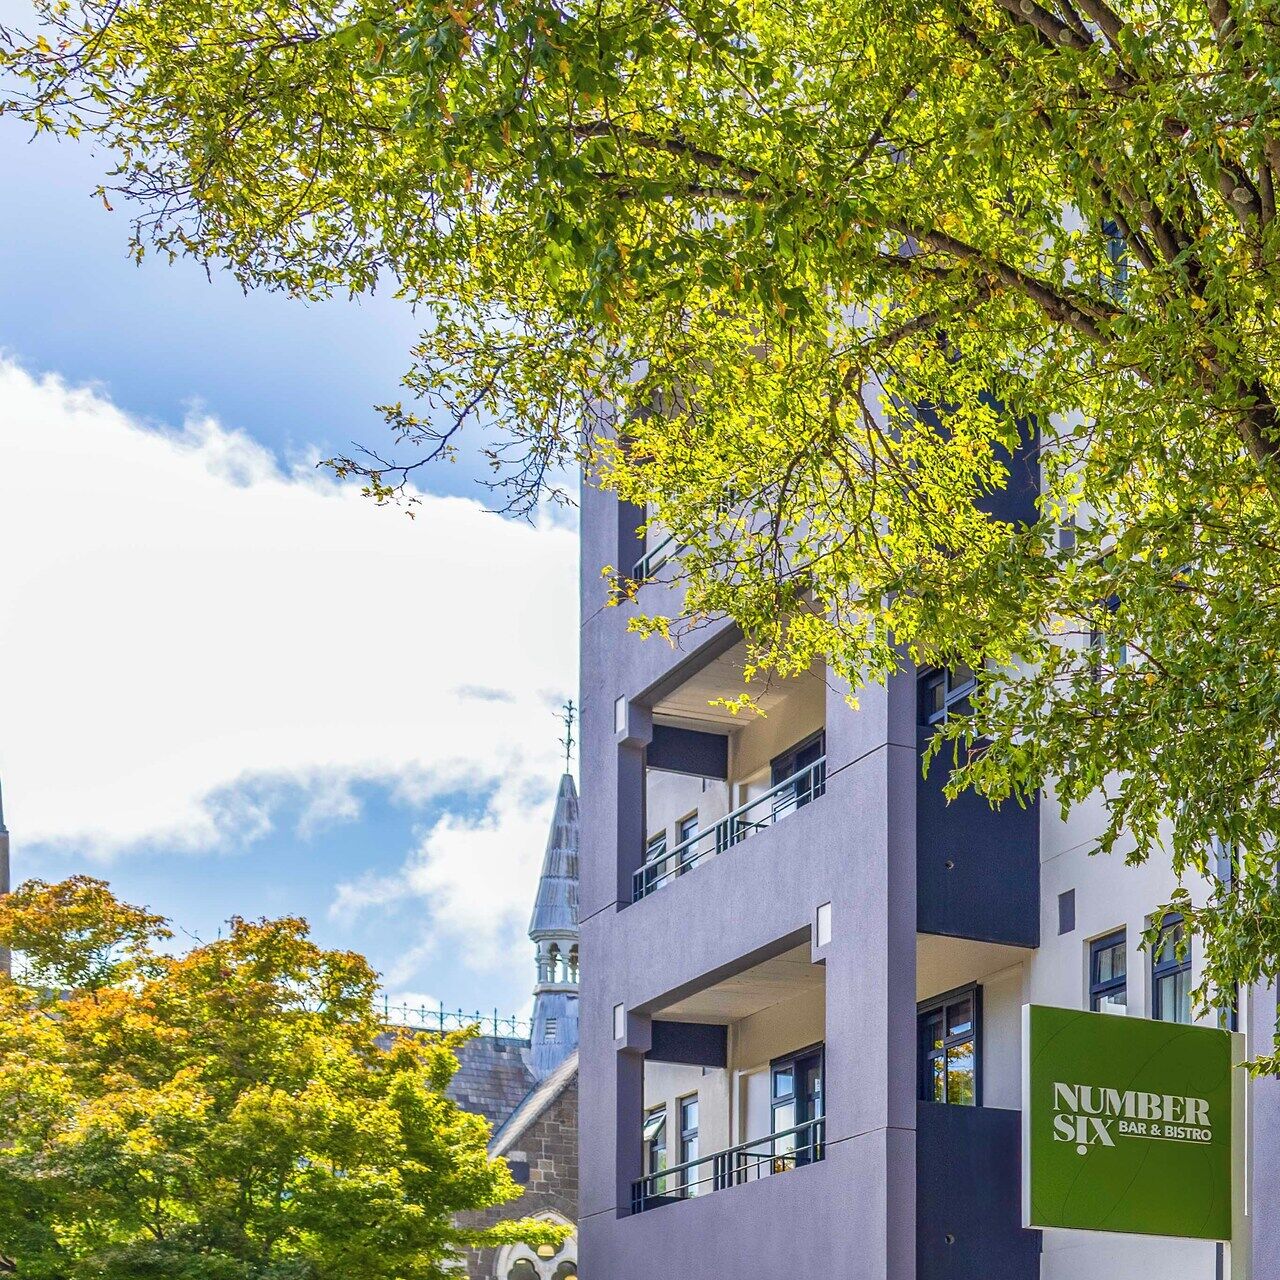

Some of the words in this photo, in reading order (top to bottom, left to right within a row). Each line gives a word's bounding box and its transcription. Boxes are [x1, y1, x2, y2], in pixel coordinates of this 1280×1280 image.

[1053, 1082, 1212, 1127] NUMBER
[1053, 1113, 1116, 1155] SIX
[1119, 1120, 1147, 1135] BAR
[1150, 1124, 1161, 1136] &
[1164, 1125, 1213, 1141] BISTRO
